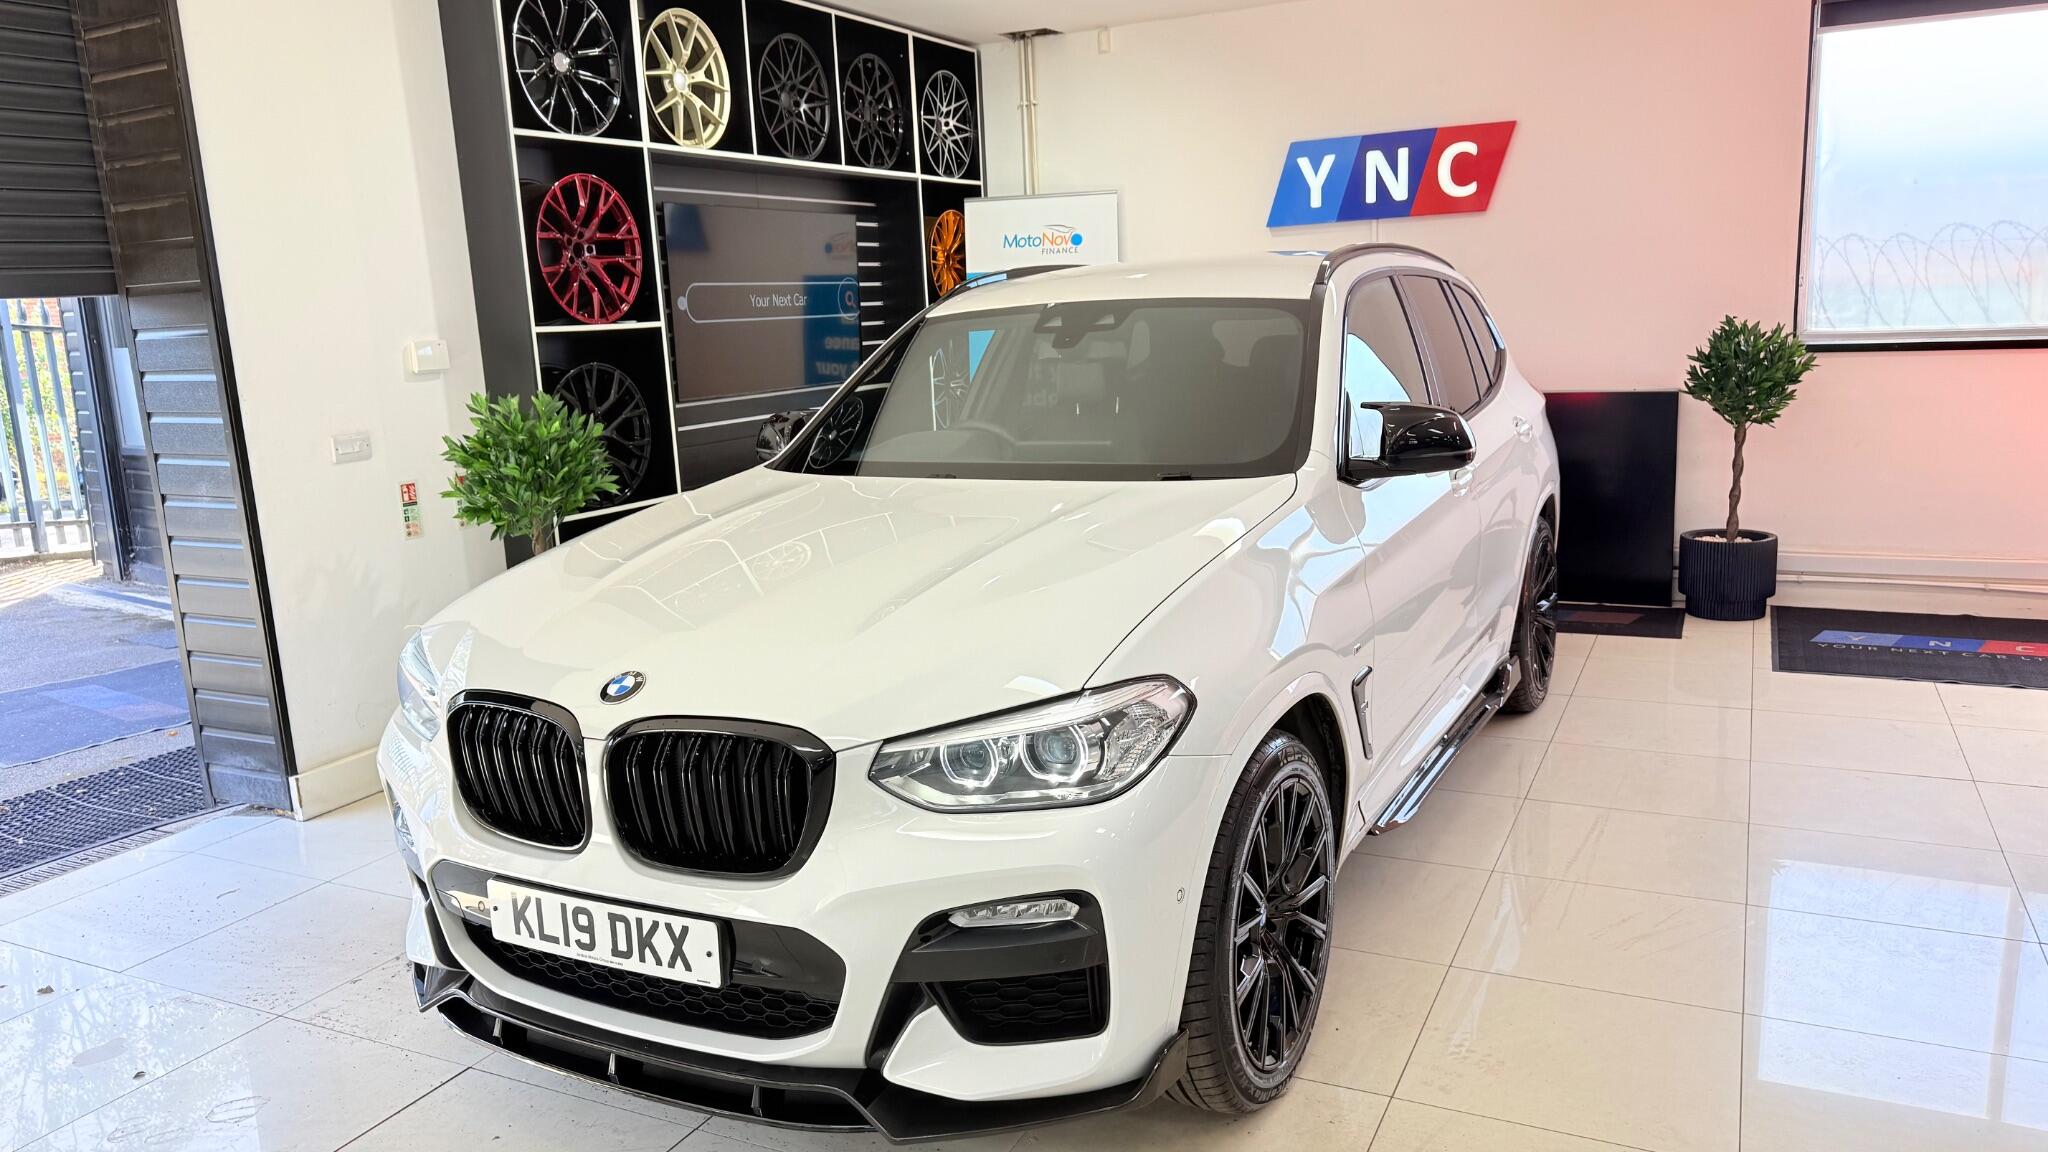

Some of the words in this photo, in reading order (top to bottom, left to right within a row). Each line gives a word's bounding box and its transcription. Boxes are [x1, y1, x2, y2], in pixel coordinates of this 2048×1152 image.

[1296, 141, 1478, 208] YNC
[1041, 246, 1079, 255] FINANCE
[749, 294, 769, 307] Your
[772, 293, 792, 306] Next
[793, 292, 807, 306] Car
[1818, 643, 1878, 651] YOUR
[1890, 647, 1949, 656] NEXT
[1962, 652, 2008, 660] CAR
[511, 892, 596, 952] KL19
[607, 912, 692, 972] DKX
